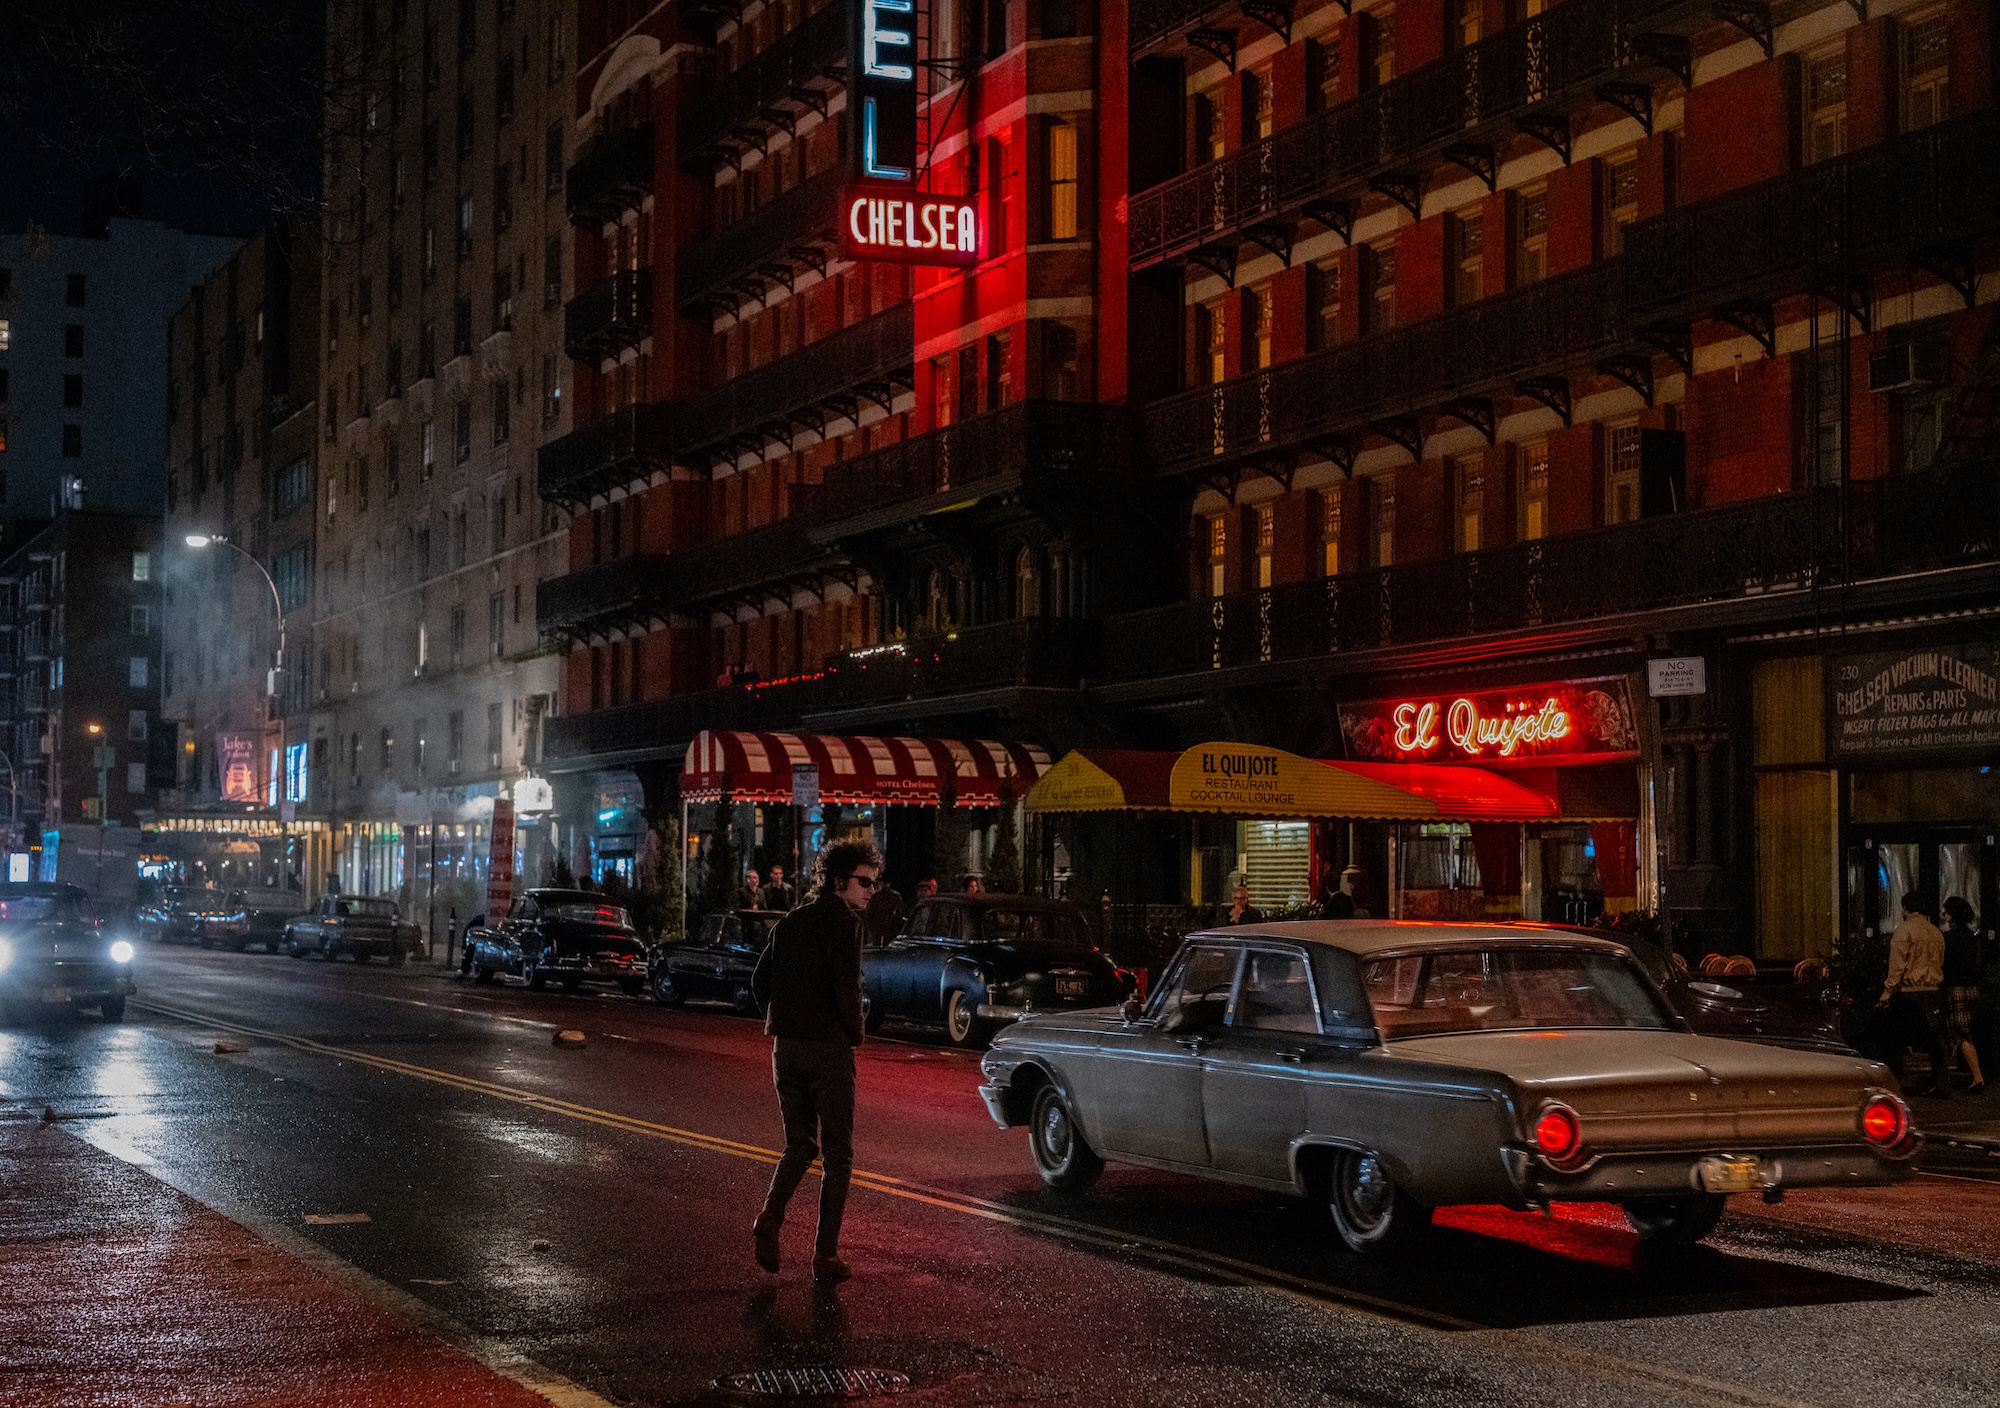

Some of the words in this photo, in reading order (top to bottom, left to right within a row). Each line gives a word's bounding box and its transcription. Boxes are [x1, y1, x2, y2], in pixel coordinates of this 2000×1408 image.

[849, 197, 976, 253] CHELSEA
[1659, 669, 1694, 677] PARKING
[1667, 661, 1685, 670] NO
[1840, 665, 1859, 681] 230
[1836, 670, 1890, 716] CHELSEA
[1890, 652, 1939, 688] VACUUM
[1940, 655, 1997, 702] CLEANER
[1884, 692, 1925, 713] REPAIRS
[1925, 697, 1932, 711] &
[1932, 688, 1967, 710] PARTS
[1393, 701, 1439, 751] El
[1843, 718, 1875, 734] INSERT
[1877, 716, 1908, 732] FILTER
[1909, 714, 1938, 729] BAGS
[1938, 714, 1950, 727] for
[1949, 711, 1969, 726] ALL
[223, 735, 253, 751] Jake's
[1839, 738, 1867, 751] Repair
[1874, 736, 1911, 748] Service
[1912, 734, 1922, 745] of
[1922, 733, 1933, 745] All
[1933, 730, 1972, 744] Electrical
[1202, 753, 1217, 773] EL
[1220, 754, 1279, 779] QUIJOTE
[876, 780, 901, 789] HOTEL
[901, 779, 937, 789] Chelsea
[1205, 777, 1280, 791] RESTAURANT
[1190, 789, 1246, 802] COCKTAIL
[1248, 792, 1295, 805] LOUNGE
